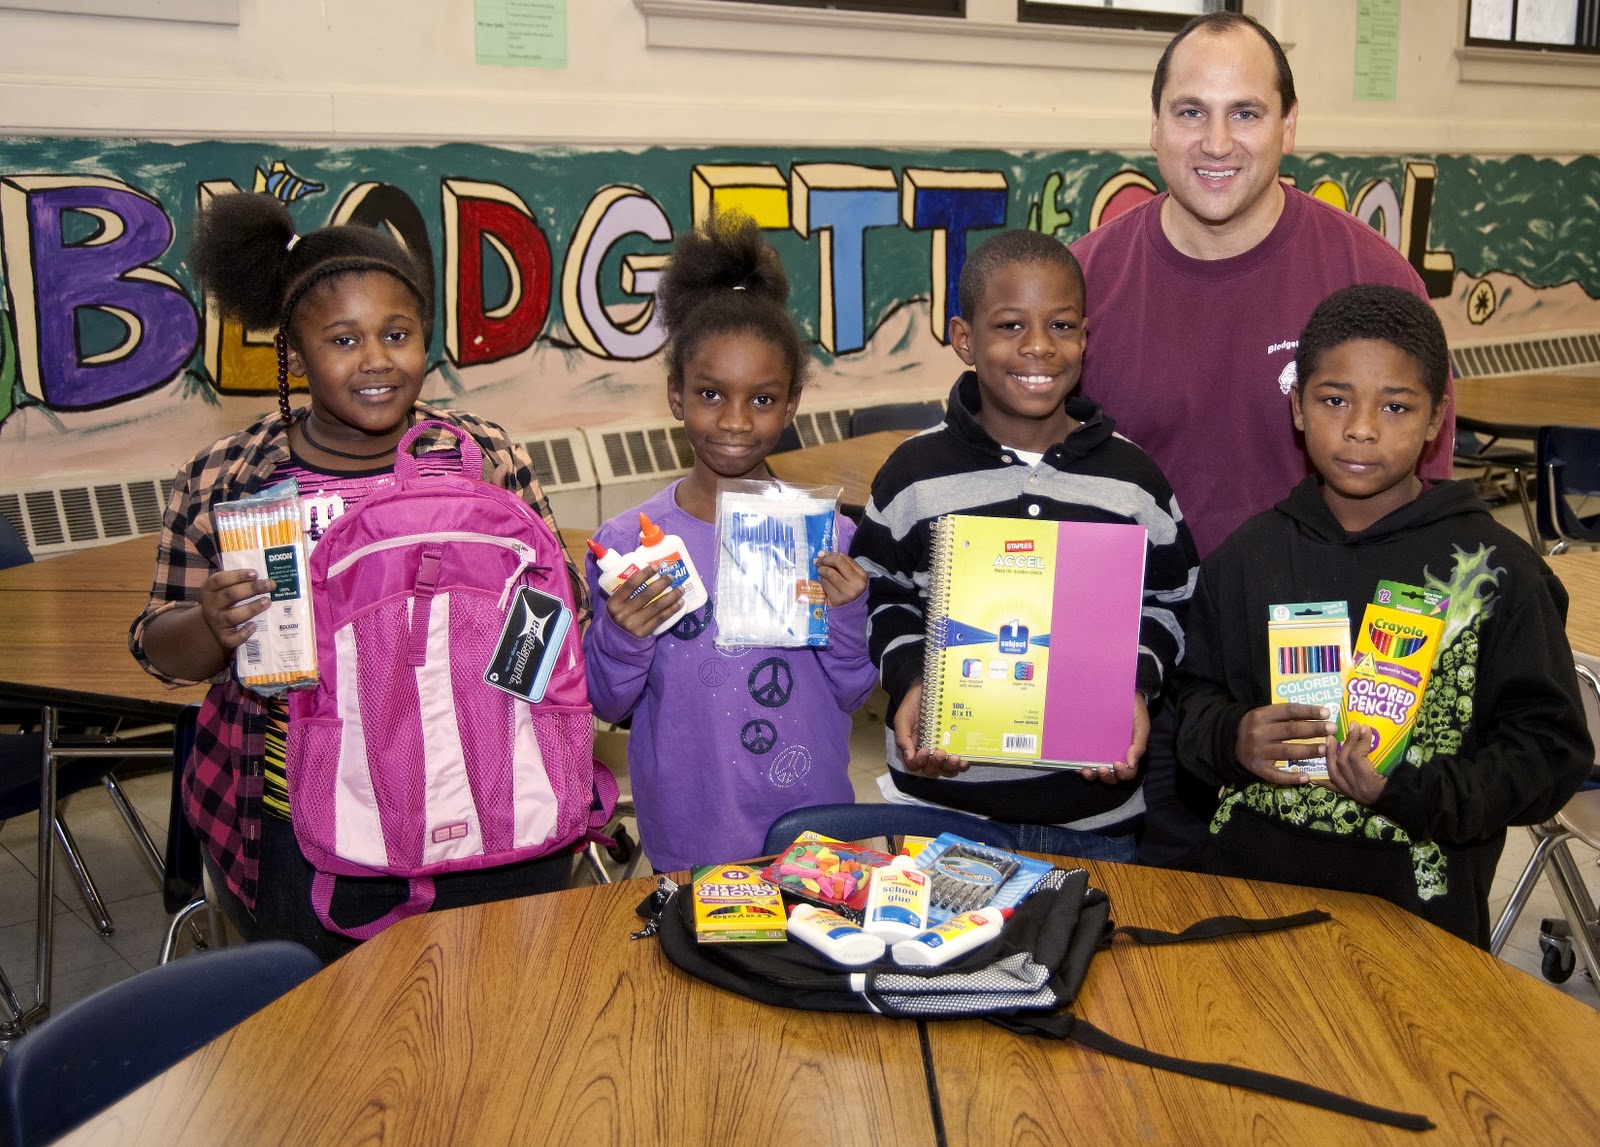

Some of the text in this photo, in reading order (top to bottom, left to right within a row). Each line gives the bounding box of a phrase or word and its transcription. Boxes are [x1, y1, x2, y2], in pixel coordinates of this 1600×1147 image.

[1267, 340, 1299, 354] Blodget
[1006, 542, 1033, 550] STAPLES
[269, 552, 293, 562] DIXON
[993, 554, 1045, 569] ACCEL
[1378, 589, 1391, 603] 12
[1276, 608, 1286, 616] 12
[1009, 619, 1019, 638] 1
[1374, 618, 1424, 638] Crayola
[1001, 641, 1026, 649] subject
[1278, 675, 1339, 696] COLORED
[1347, 678, 1415, 705] COLORED
[1290, 688, 1343, 705] PENCILS
[1348, 695, 1407, 724] PENCILS
[1298, 765, 1328, 774] OfficeMa
[701, 883, 773, 891] PENCILS
[883, 886, 918, 897] school
[888, 894, 910, 903] glue
